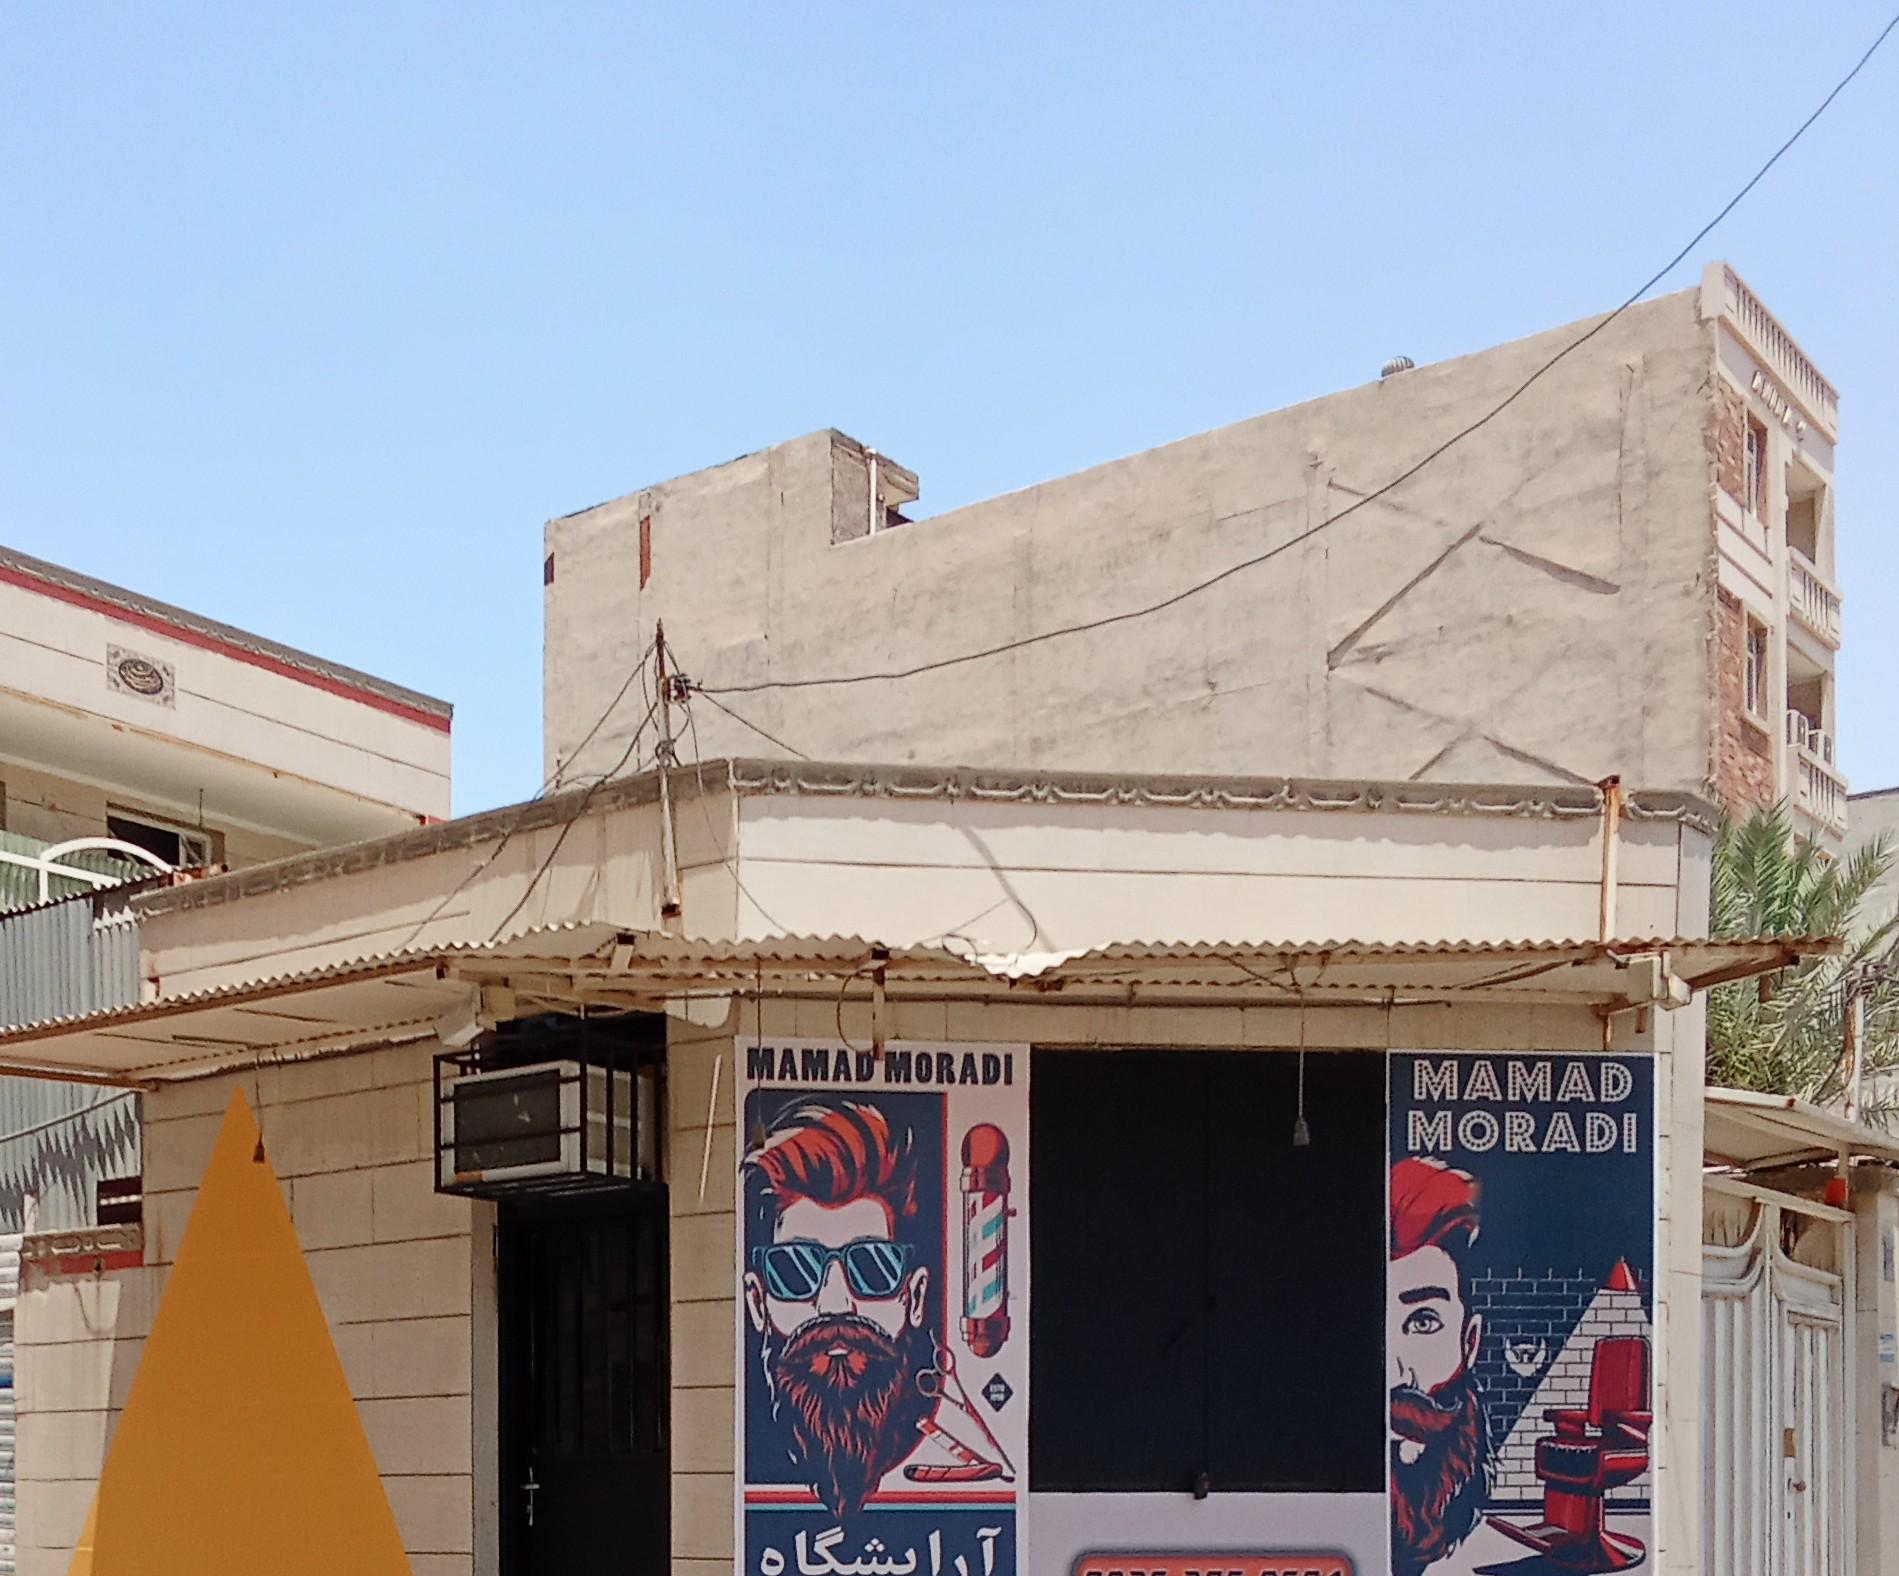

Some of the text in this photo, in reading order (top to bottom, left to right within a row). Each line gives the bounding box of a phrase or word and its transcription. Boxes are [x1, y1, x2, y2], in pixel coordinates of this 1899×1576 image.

[747, 1047, 1013, 1085] MAMAD MORADI
[1414, 1059, 1633, 1103] MAMAD
[1408, 1110, 1637, 1153] MORADI
